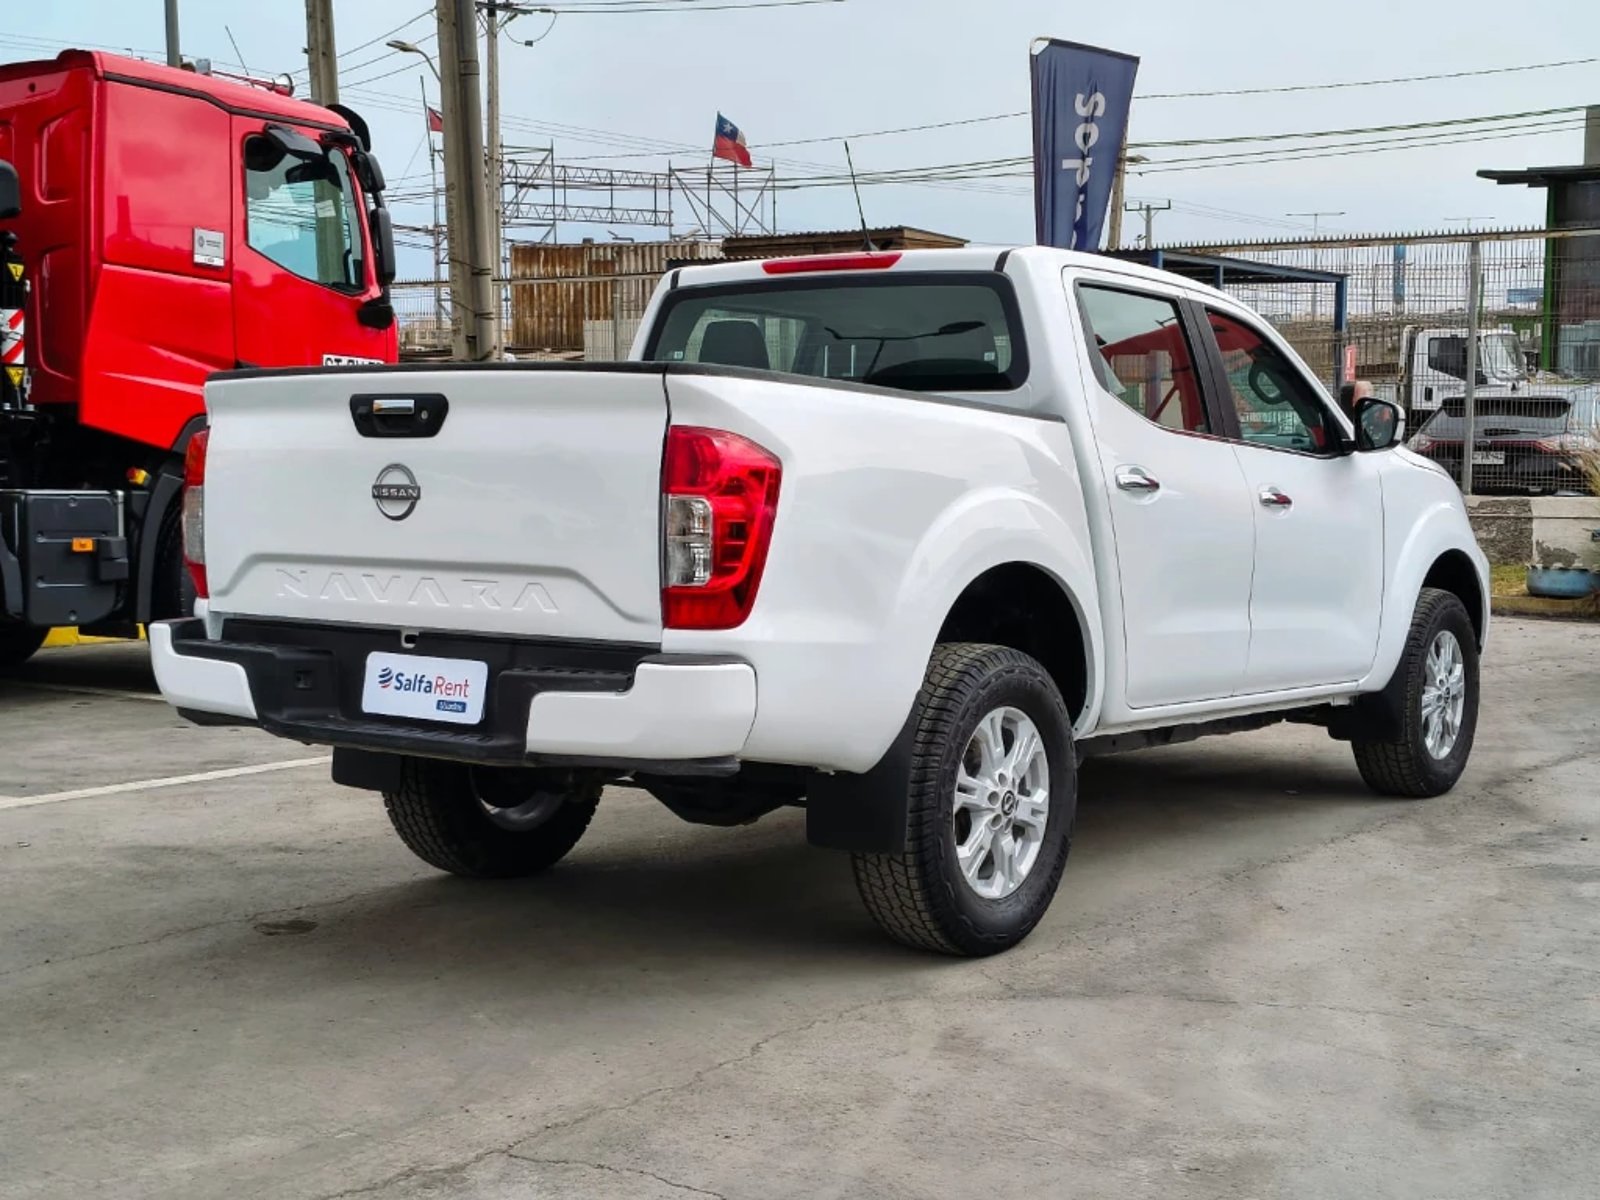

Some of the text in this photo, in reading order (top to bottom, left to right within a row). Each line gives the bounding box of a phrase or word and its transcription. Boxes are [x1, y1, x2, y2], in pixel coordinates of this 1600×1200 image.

[372, 487, 419, 498] NISSAN
[275, 568, 560, 613] NAVARA
[393, 672, 470, 698] SalfaRent
